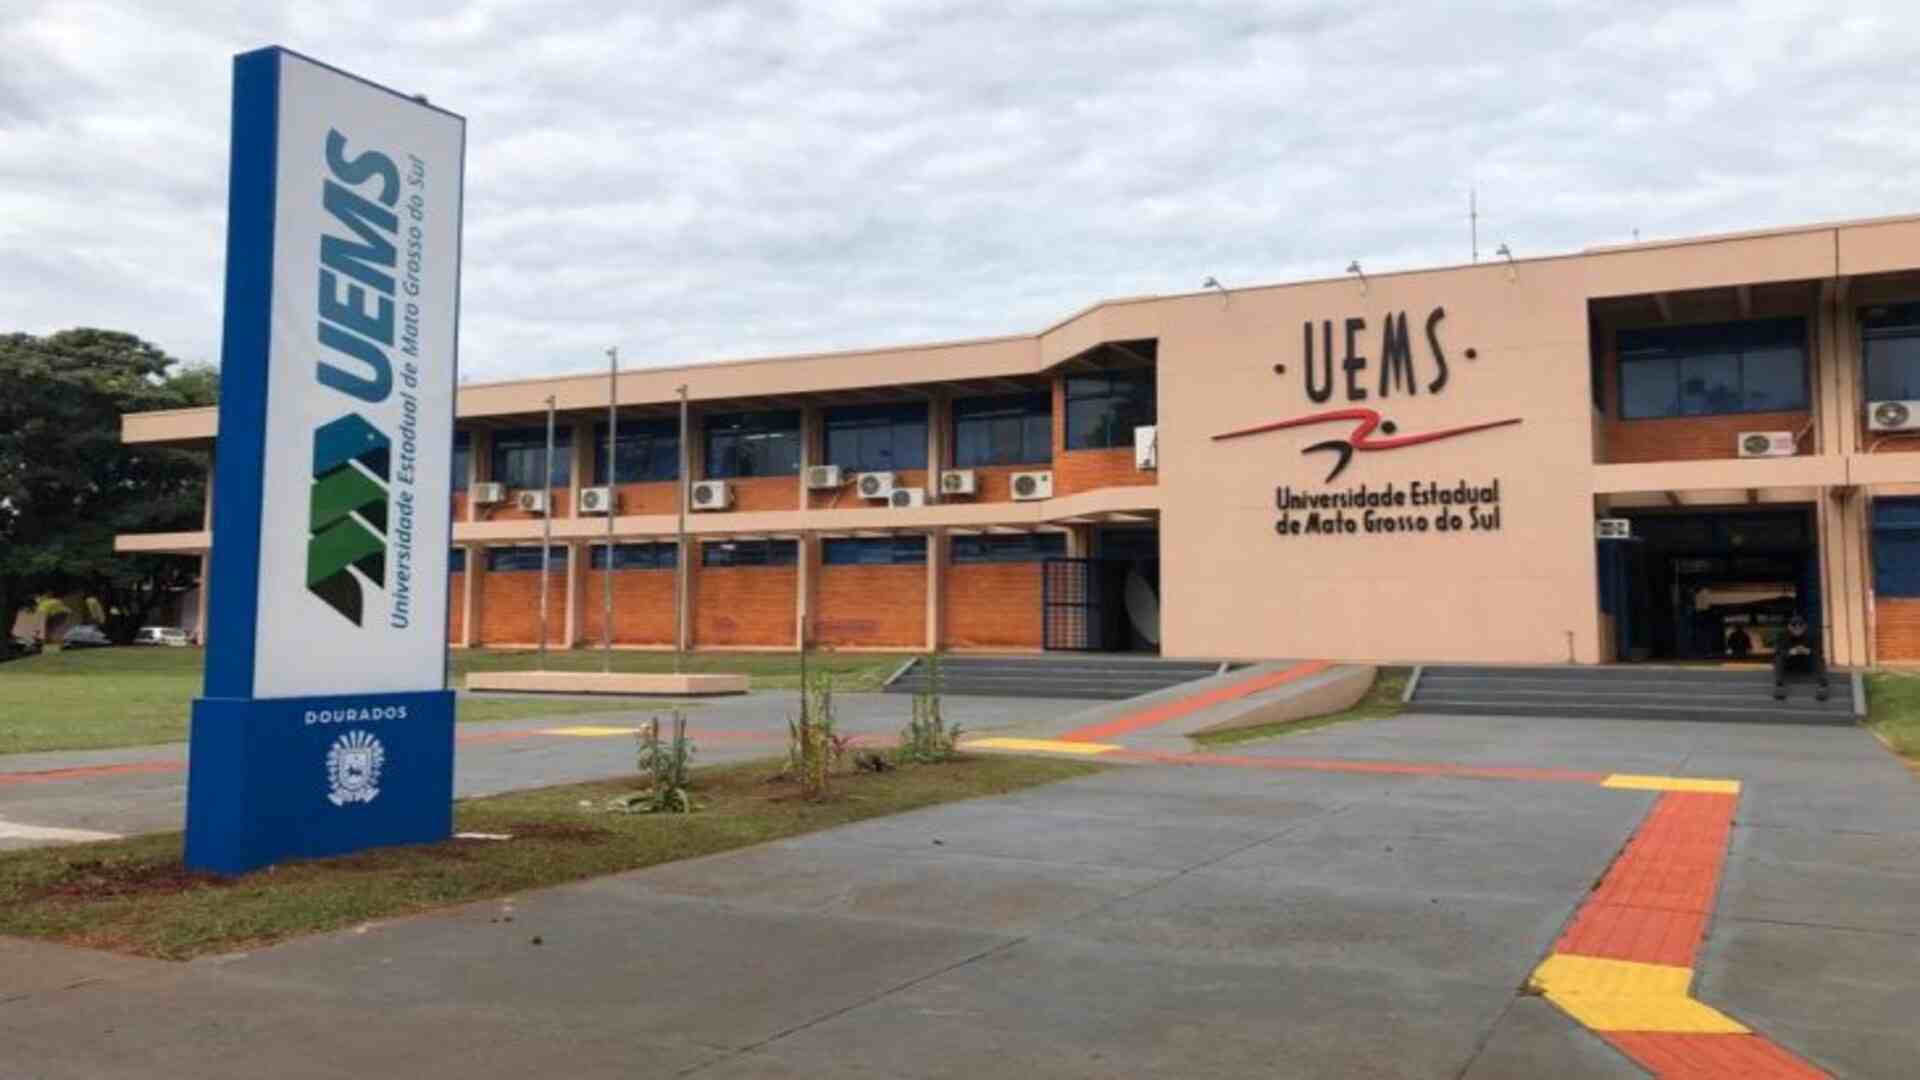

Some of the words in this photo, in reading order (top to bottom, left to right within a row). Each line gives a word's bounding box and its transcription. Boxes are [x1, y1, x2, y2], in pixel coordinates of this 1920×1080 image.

[406, 155, 425, 188] Sul
[406, 194, 425, 222] do
[316, 127, 400, 404] UEMS
[402, 226, 424, 300] Grosso
[402, 303, 420, 353] Mato
[1304, 306, 1449, 403] UEMS
[399, 362, 418, 389] de
[397, 392, 418, 486] Estadual
[1276, 483, 1406, 510] Universidade
[1410, 478, 1499, 506] Estadual
[1275, 511, 1301, 535] de
[1304, 510, 1357, 534] Mato
[1363, 509, 1429, 533] Grosso
[1434, 507, 1463, 531] do
[1468, 505, 1500, 530] Sul
[391, 490, 415, 629] Universidade
[304, 705, 408, 725] DOURADOS
